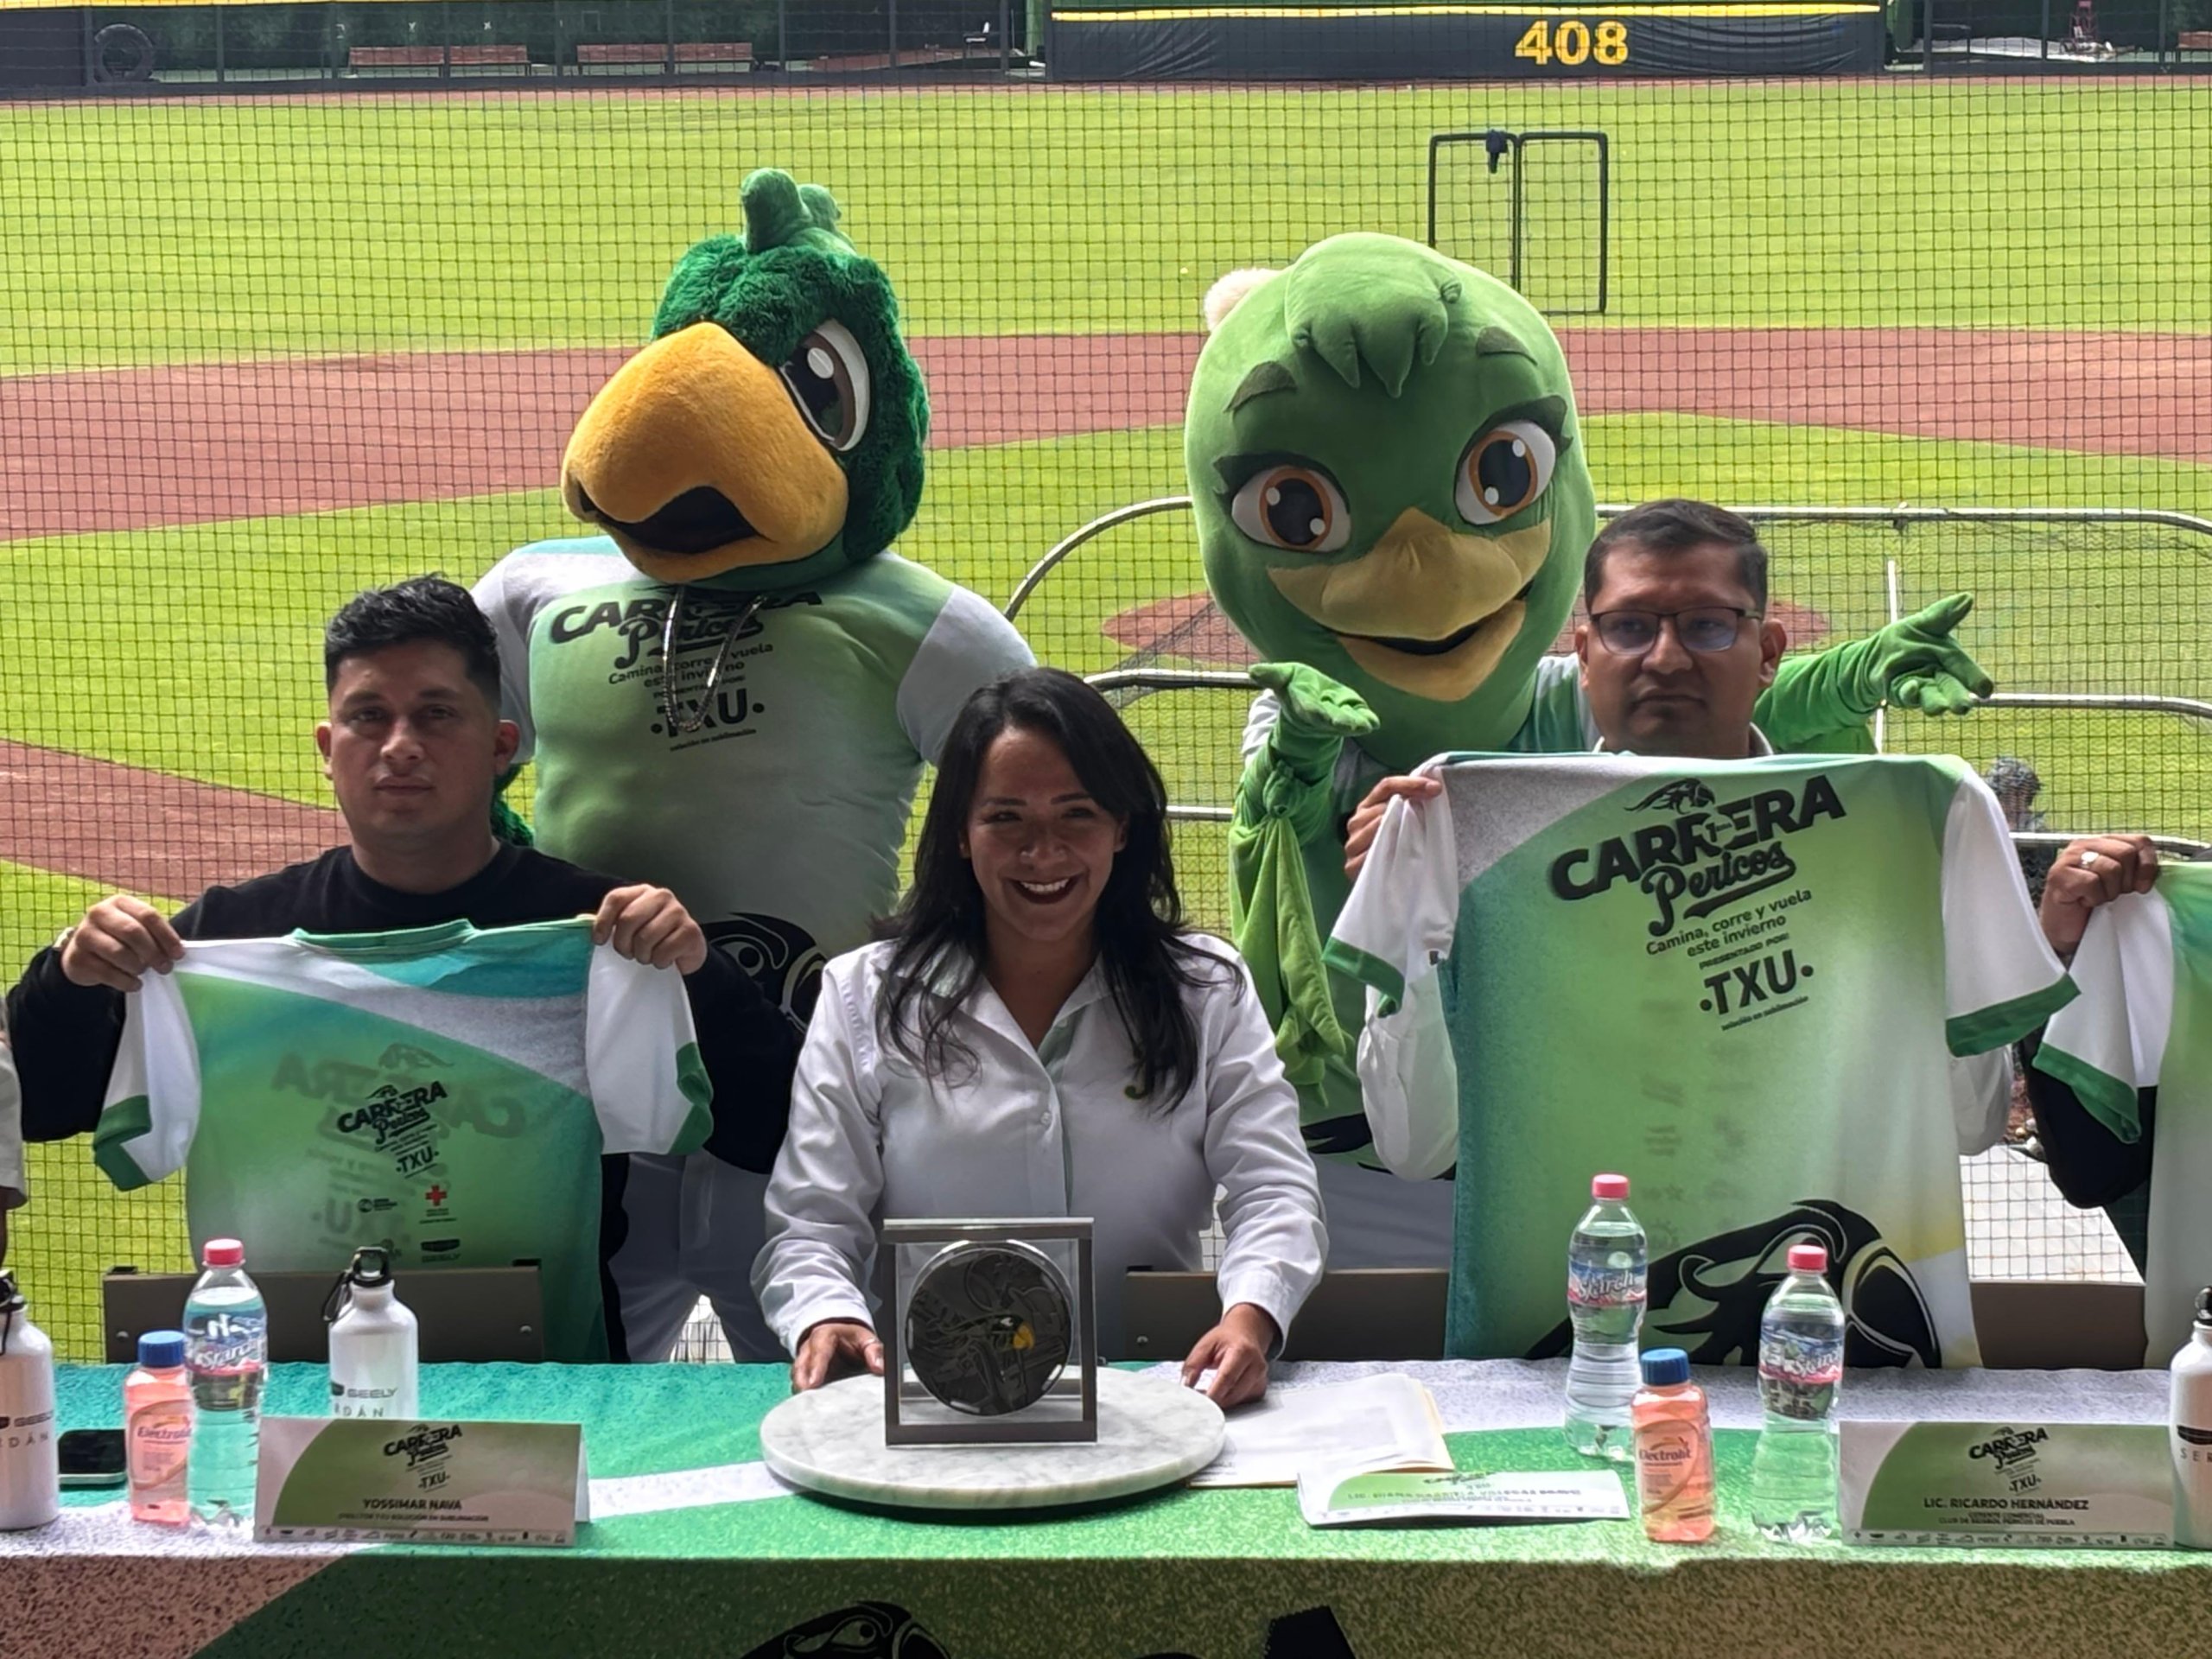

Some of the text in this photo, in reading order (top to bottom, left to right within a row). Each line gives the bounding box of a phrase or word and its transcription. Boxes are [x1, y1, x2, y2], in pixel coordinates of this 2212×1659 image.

[1515, 20, 1629, 65] 408
[731, 643, 773, 659] vuela
[1549, 775, 1847, 900] CARRERA
[1641, 841, 1796, 937] Pericos
[1646, 889, 1812, 955] Camina, corre y vuela
[1687, 914, 1787, 957] este invierno
[429, 1499, 462, 1510] NAVA
[1923, 1497, 2089, 1510] LIC. RICARDO HERNÁNDEZ
